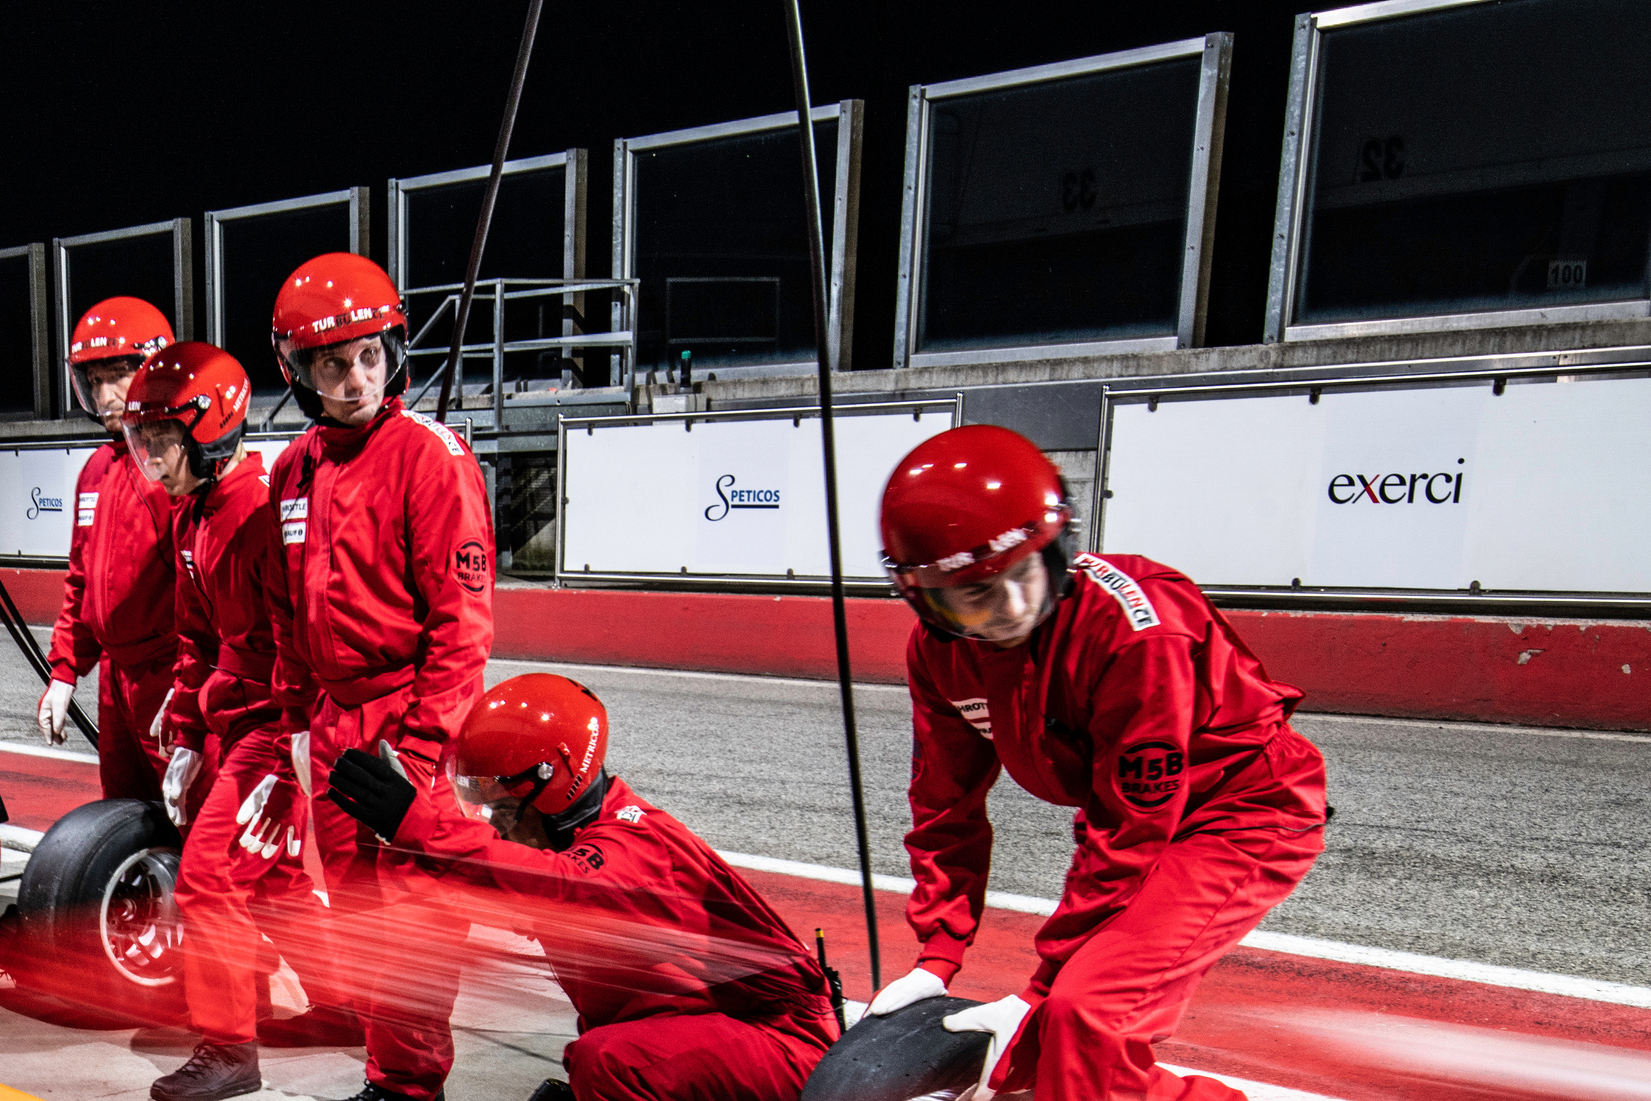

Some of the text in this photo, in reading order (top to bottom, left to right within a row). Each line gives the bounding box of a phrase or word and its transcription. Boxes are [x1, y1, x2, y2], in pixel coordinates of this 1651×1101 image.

[1551, 264, 1584, 284] 100
[1327, 457, 1466, 505] exerci
[26, 486, 64, 521] SPETICOS
[704, 474, 781, 522] SPETICOS
[456, 550, 486, 572] M5B
[1117, 752, 1185, 781] M5B
[1121, 779, 1182, 797] BRAKES
